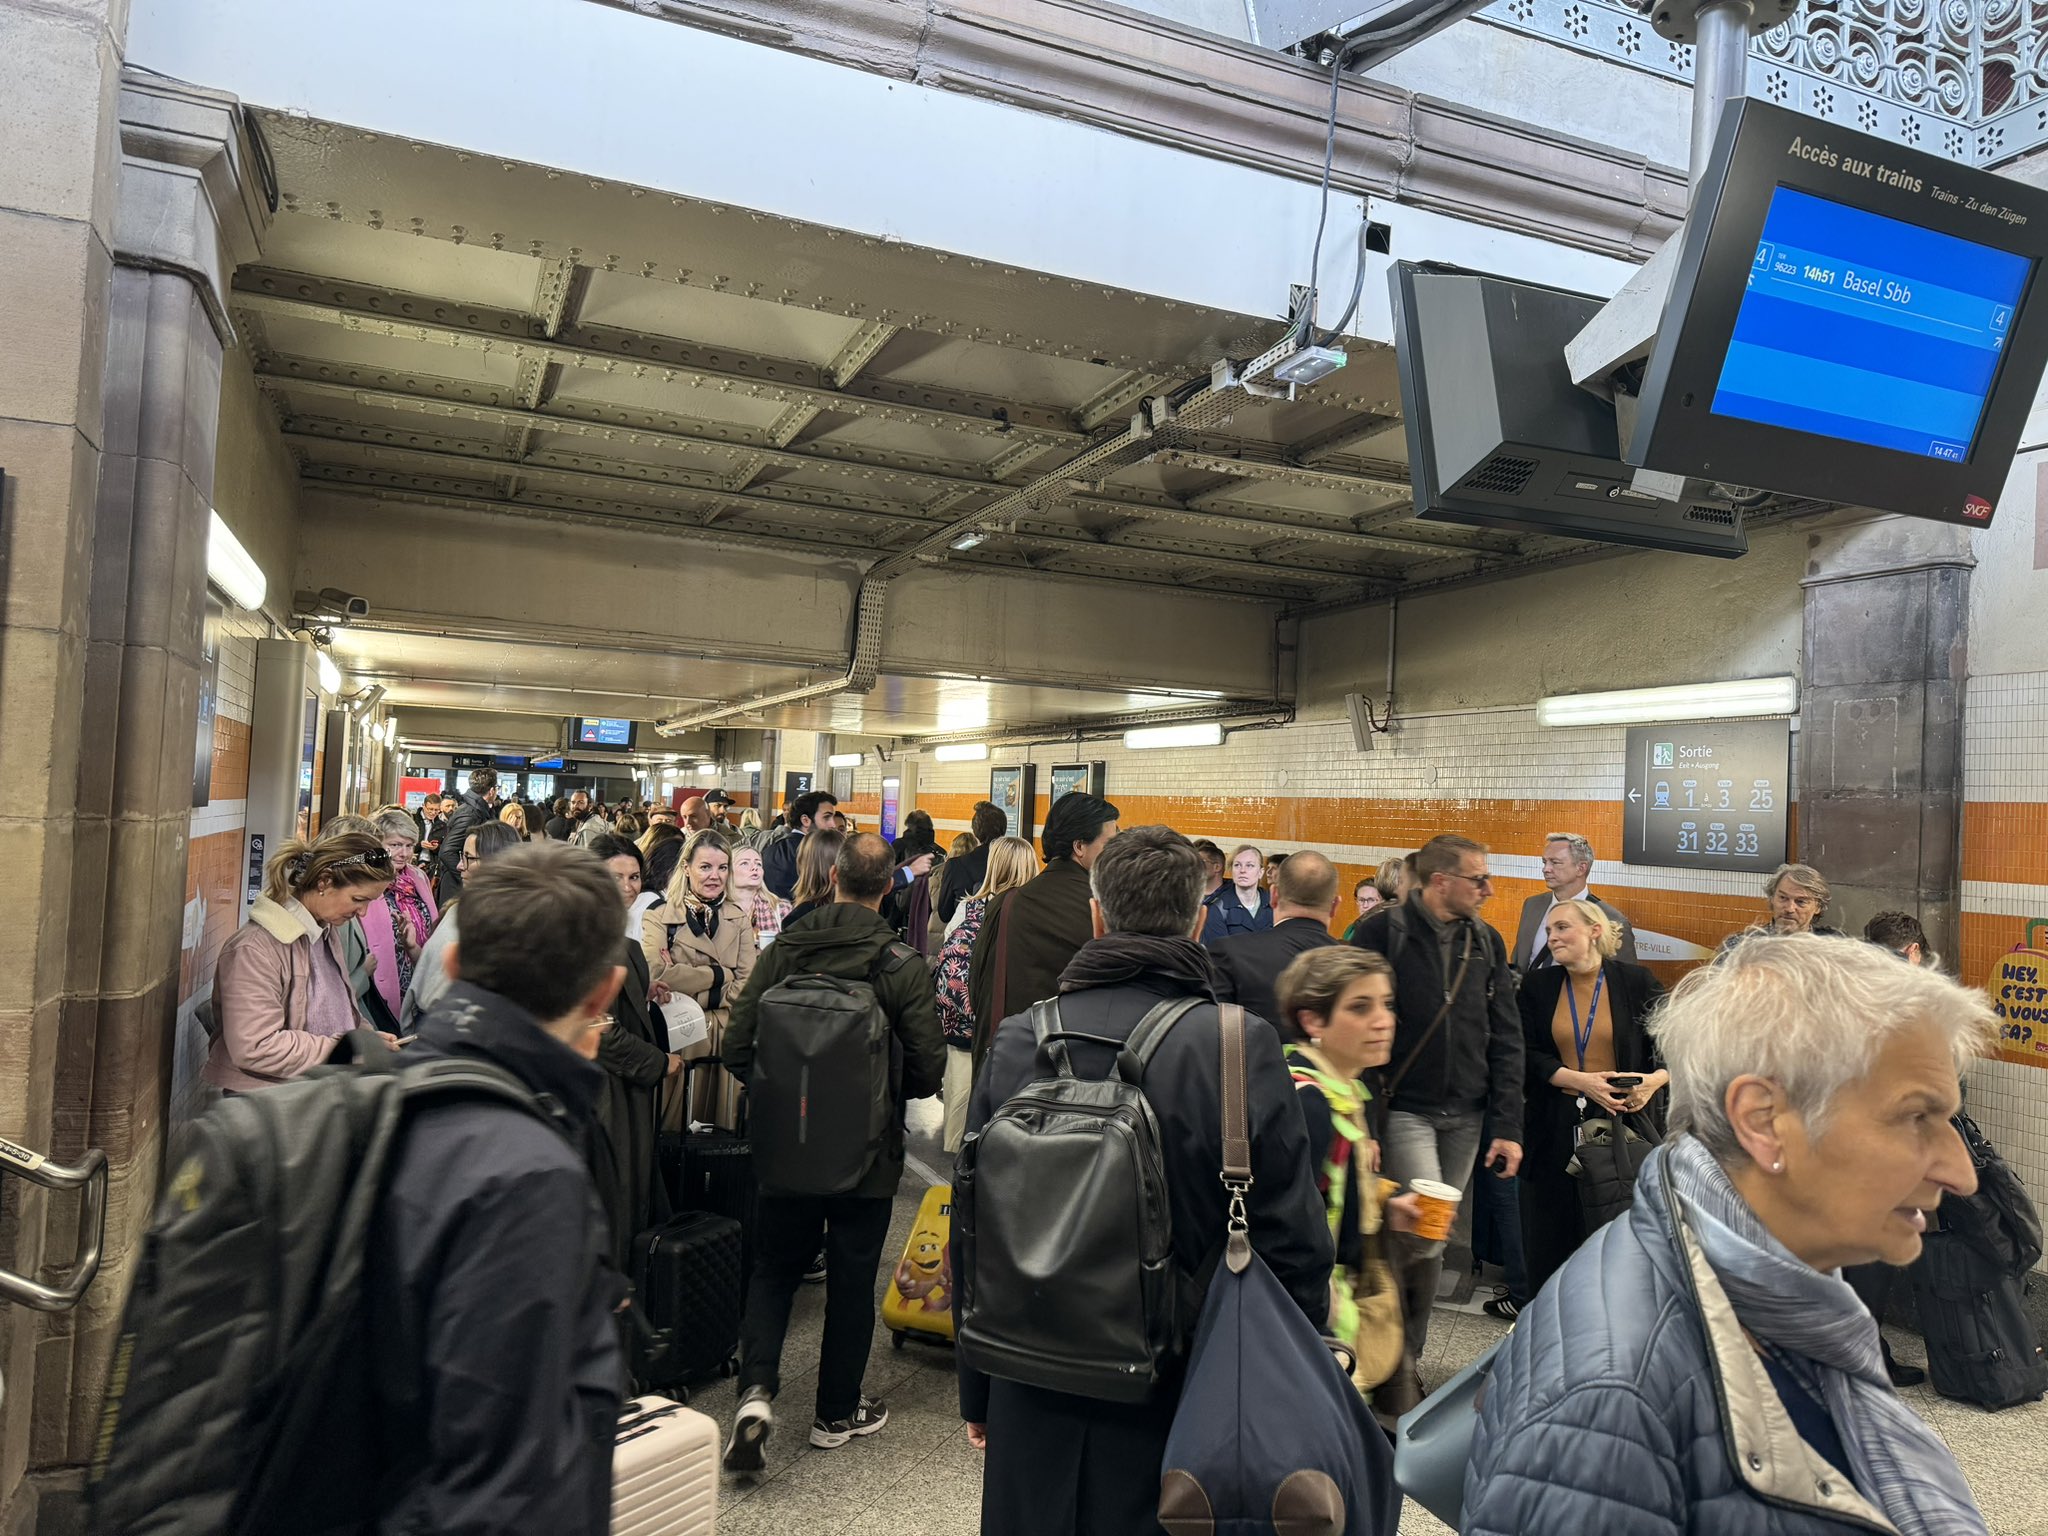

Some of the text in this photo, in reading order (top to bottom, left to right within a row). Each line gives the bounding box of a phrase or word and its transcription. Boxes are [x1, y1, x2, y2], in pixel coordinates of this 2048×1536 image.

[1788, 136, 1923, 193] Accès aux trains
[1930, 186, 1959, 205] Trains
[1965, 197, 1978, 210] Zu
[1979, 201, 1998, 217] den
[1998, 206, 2028, 226] Zügen
[1756, 248, 1766, 265] 4
[1774, 261, 1911, 304] 96223 14h51 Basel Sbb
[1995, 311, 2005, 326] 4
[1963, 502, 1991, 517] SNCF
[1679, 745, 1713, 758] Sortie
[1685, 789, 1694, 808] 1
[1719, 789, 1730, 808] 3
[1749, 789, 1773, 809] 25
[1677, 831, 1759, 853] 31 32 33
[2001, 985, 2048, 1003] C'EST
